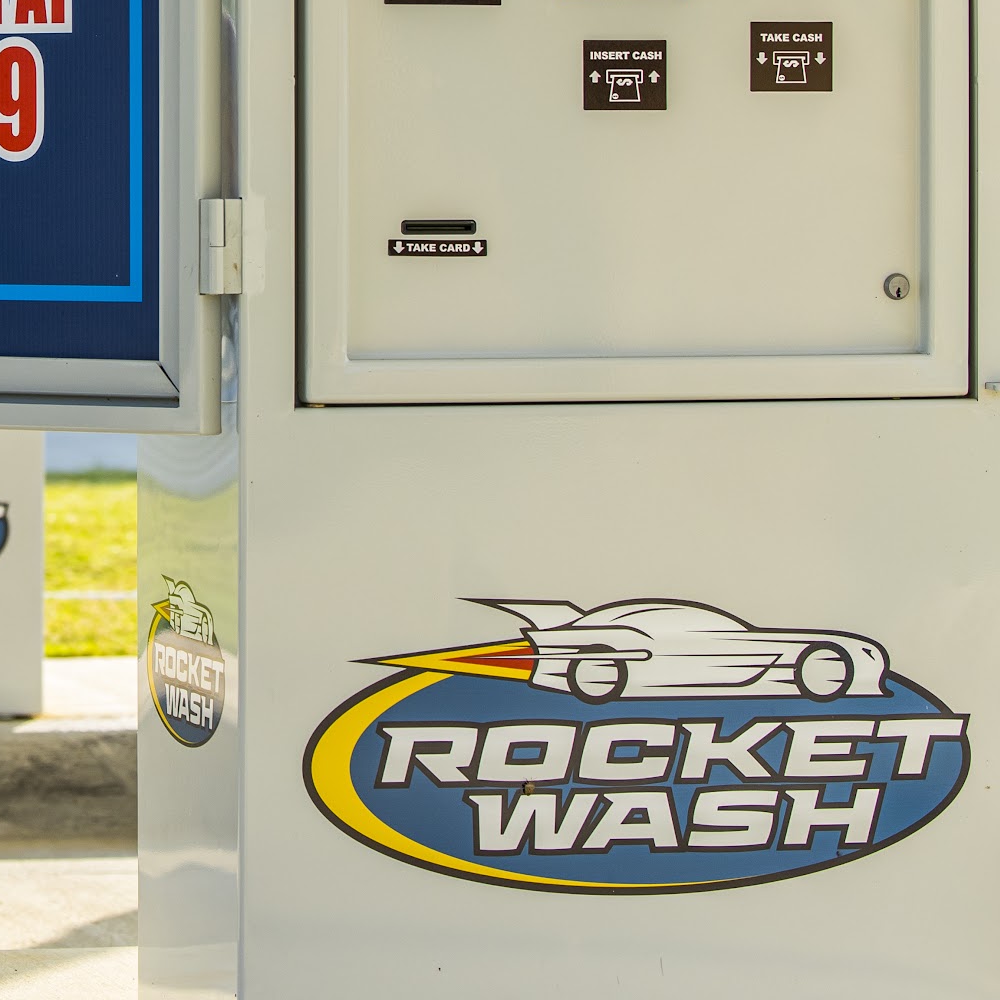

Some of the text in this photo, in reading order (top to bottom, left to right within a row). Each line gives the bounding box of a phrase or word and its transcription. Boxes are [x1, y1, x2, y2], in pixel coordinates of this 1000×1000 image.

[590, 51, 662, 60] INSERT CASH
[760, 33, 823, 42] TAKE CASH
[406, 243, 471, 252] TAKE CARD
[154, 642, 224, 693] ROCKET
[165, 683, 214, 730] WASH
[377, 715, 968, 787] ROCKET
[466, 786, 884, 853] WASH
